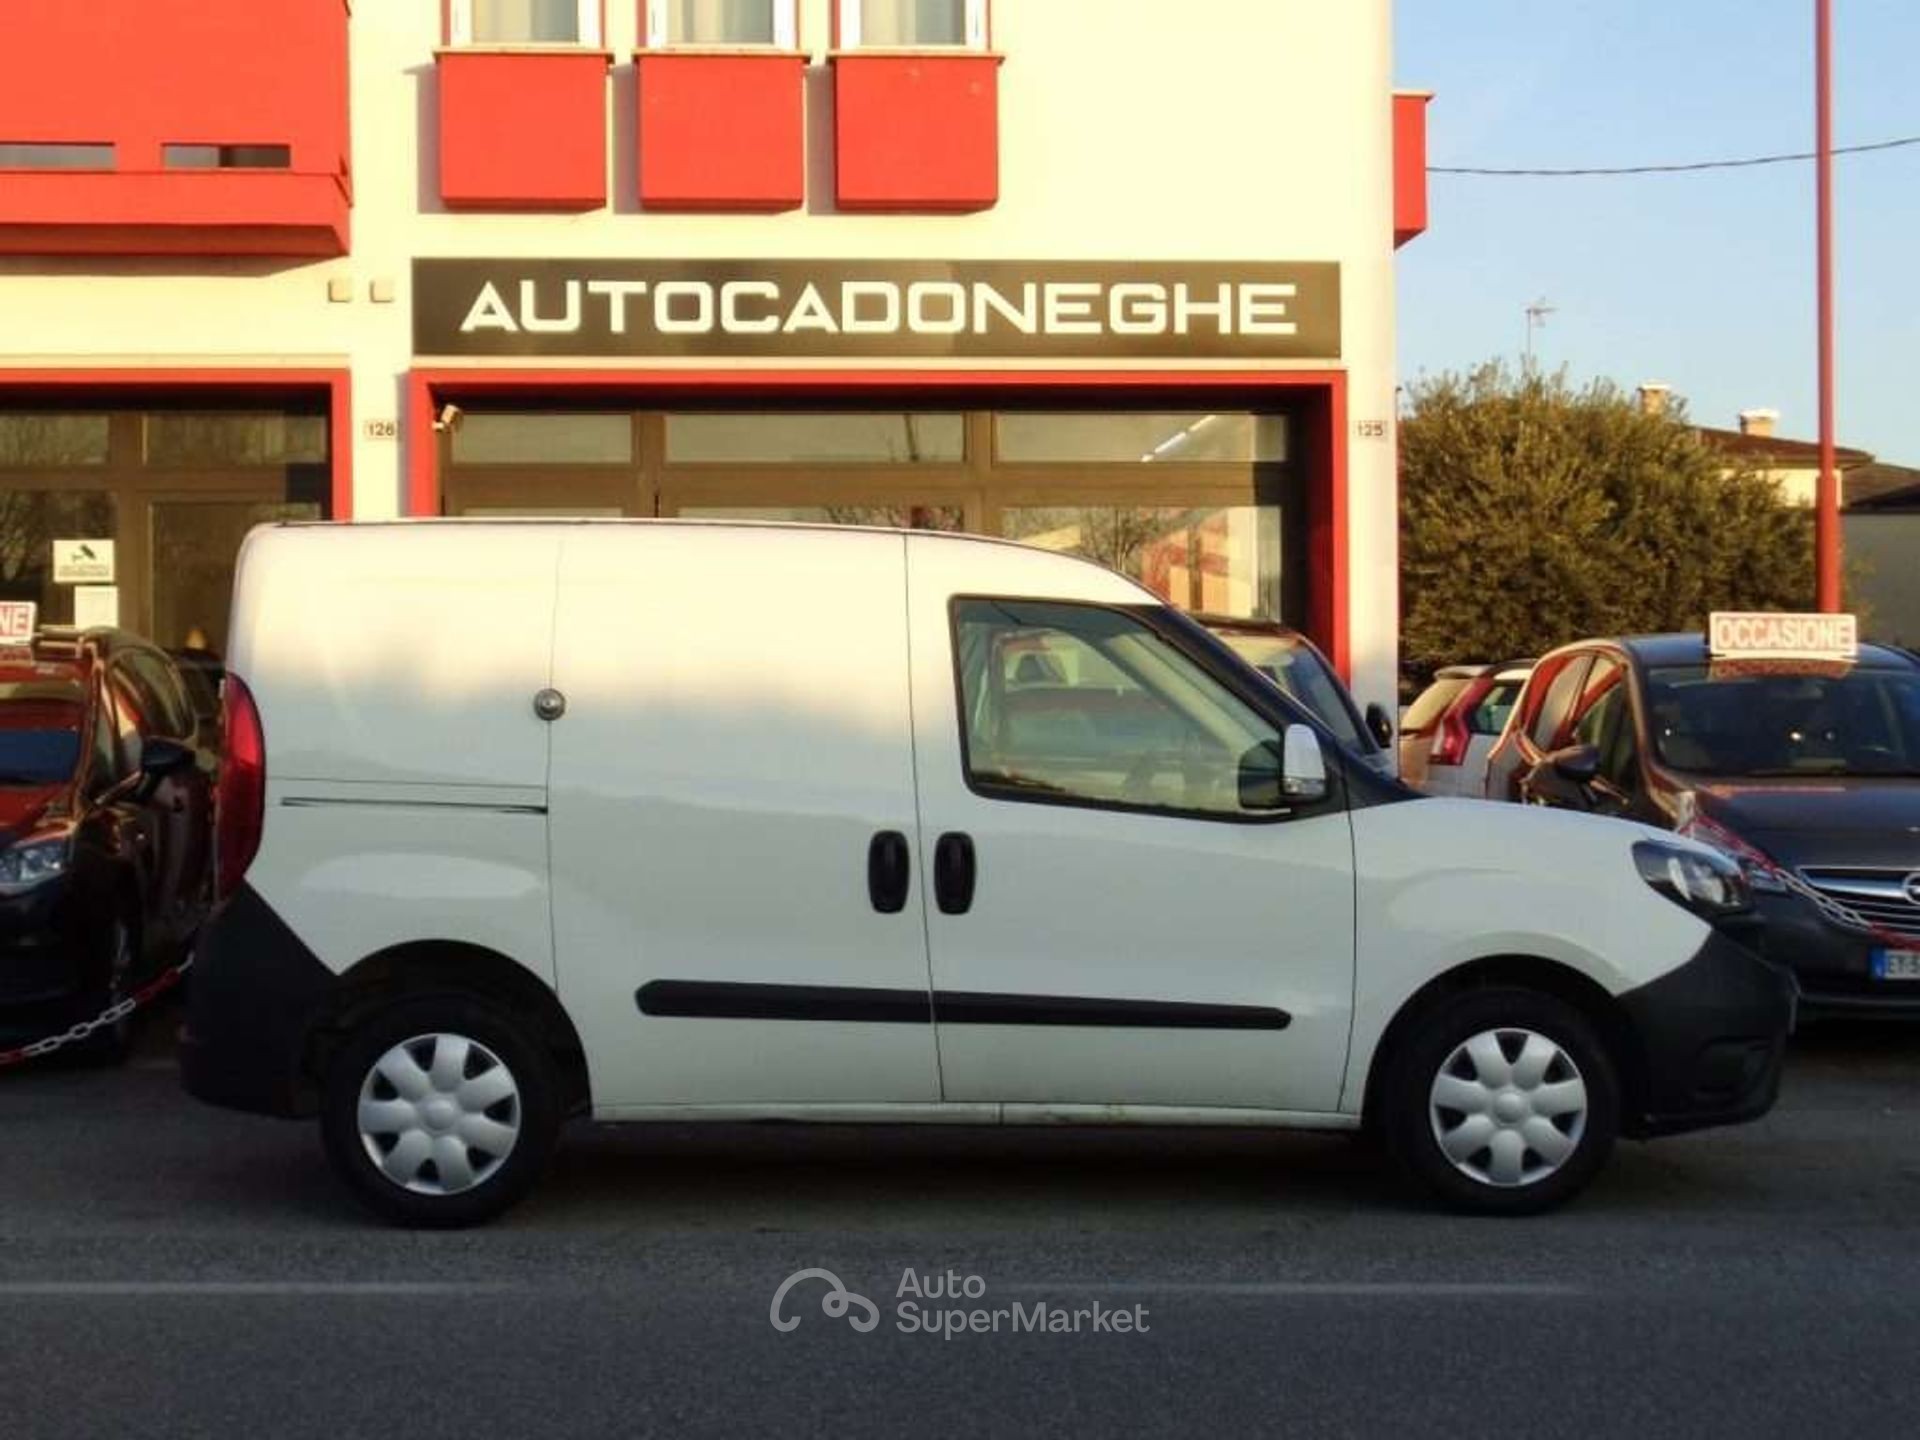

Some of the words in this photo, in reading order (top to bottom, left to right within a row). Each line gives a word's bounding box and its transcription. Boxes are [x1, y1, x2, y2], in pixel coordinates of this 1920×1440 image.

[460, 279, 1298, 336] AUTOCADONEGHE
[369, 422, 395, 437] 126
[1358, 422, 1384, 437] 125
[1716, 617, 1852, 651] OCCASIONE
